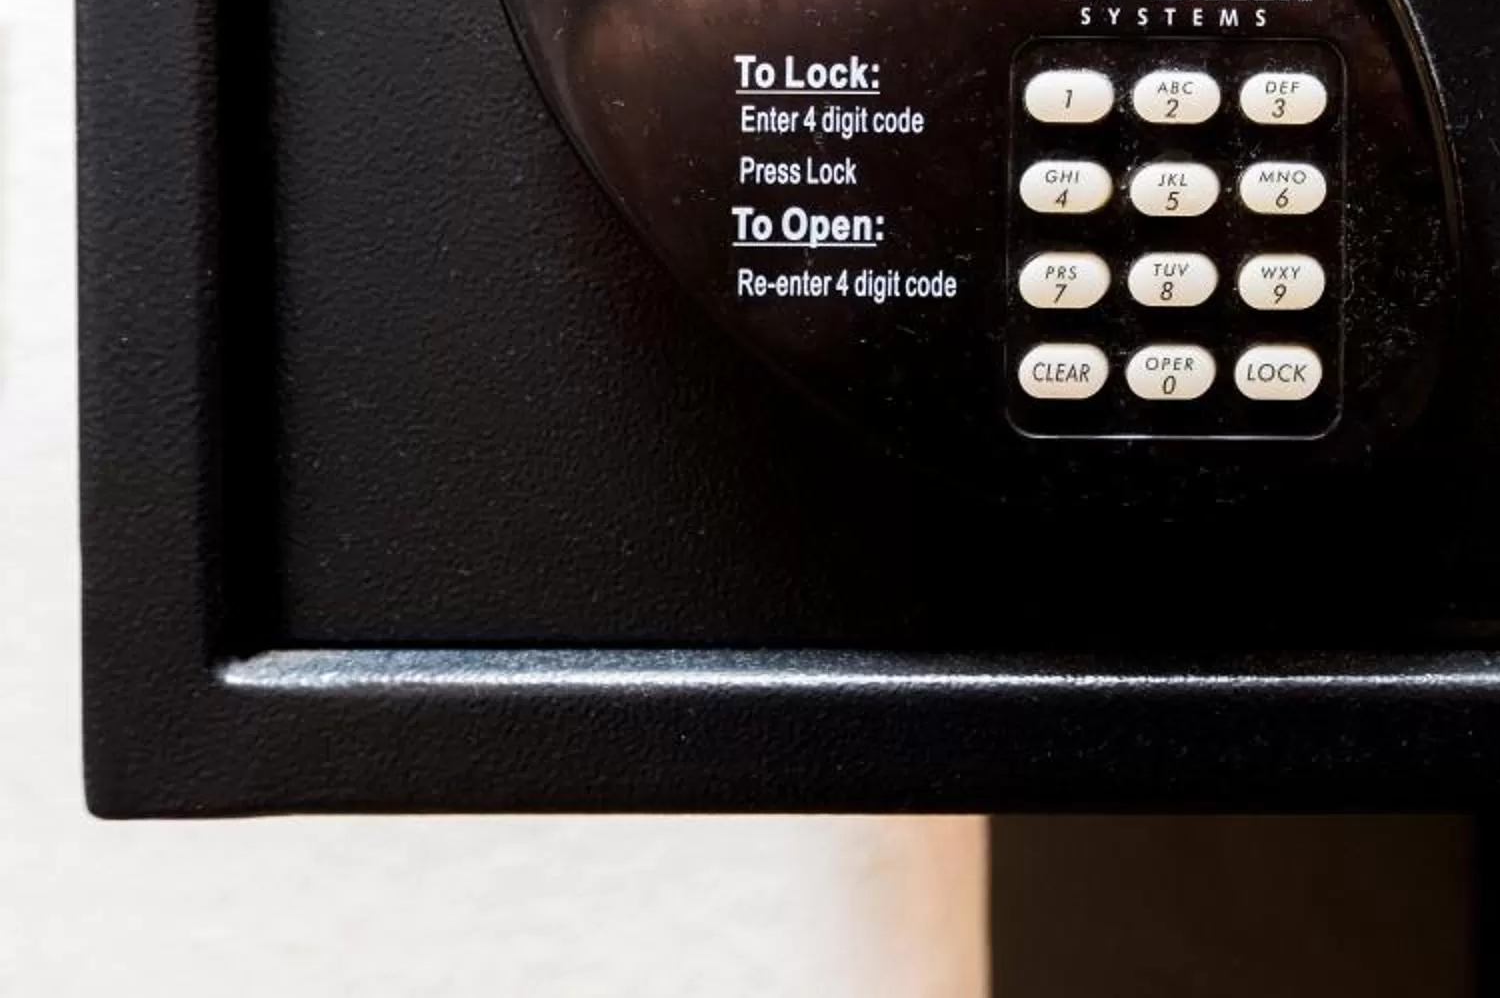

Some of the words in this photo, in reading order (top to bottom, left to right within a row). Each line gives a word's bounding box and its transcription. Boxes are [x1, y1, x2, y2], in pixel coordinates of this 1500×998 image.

[1080, 8, 1266, 26] SYSTEMS
[734, 55, 776, 89] To
[785, 55, 880, 89] Lock:
[1157, 82, 1193, 95] ABC
[1265, 81, 1300, 94] DEF
[1064, 90, 1073, 108] 1
[1166, 99, 1179, 119] 2
[1271, 99, 1286, 119] 3
[741, 106, 799, 133] Enter
[803, 106, 816, 133] 4
[822, 106, 868, 140] digit
[873, 106, 924, 134] code
[739, 156, 801, 185] Press
[807, 156, 857, 185] Lock
[1045, 170, 1080, 184] GHI
[1259, 171, 1307, 184] MNO
[1158, 174, 1188, 187] JKL
[1055, 190, 1069, 208] 4
[1165, 192, 1180, 211] 5
[1275, 189, 1289, 208] 6
[732, 207, 773, 241] To
[781, 207, 884, 248] Open:
[1045, 267, 1077, 280] PRS
[1153, 263, 1189, 276] TUV
[1261, 266, 1301, 279] WXY
[737, 268, 832, 297] Re-enter
[835, 269, 848, 297] 4
[854, 269, 900, 303] digit
[905, 270, 957, 298] code
[1053, 284, 1067, 303] 7
[1160, 282, 1173, 301] 8
[1273, 284, 1287, 304] 9
[1032, 363, 1091, 383] CLEAR
[1145, 358, 1194, 371] OPER
[1247, 364, 1307, 383] LOCK
